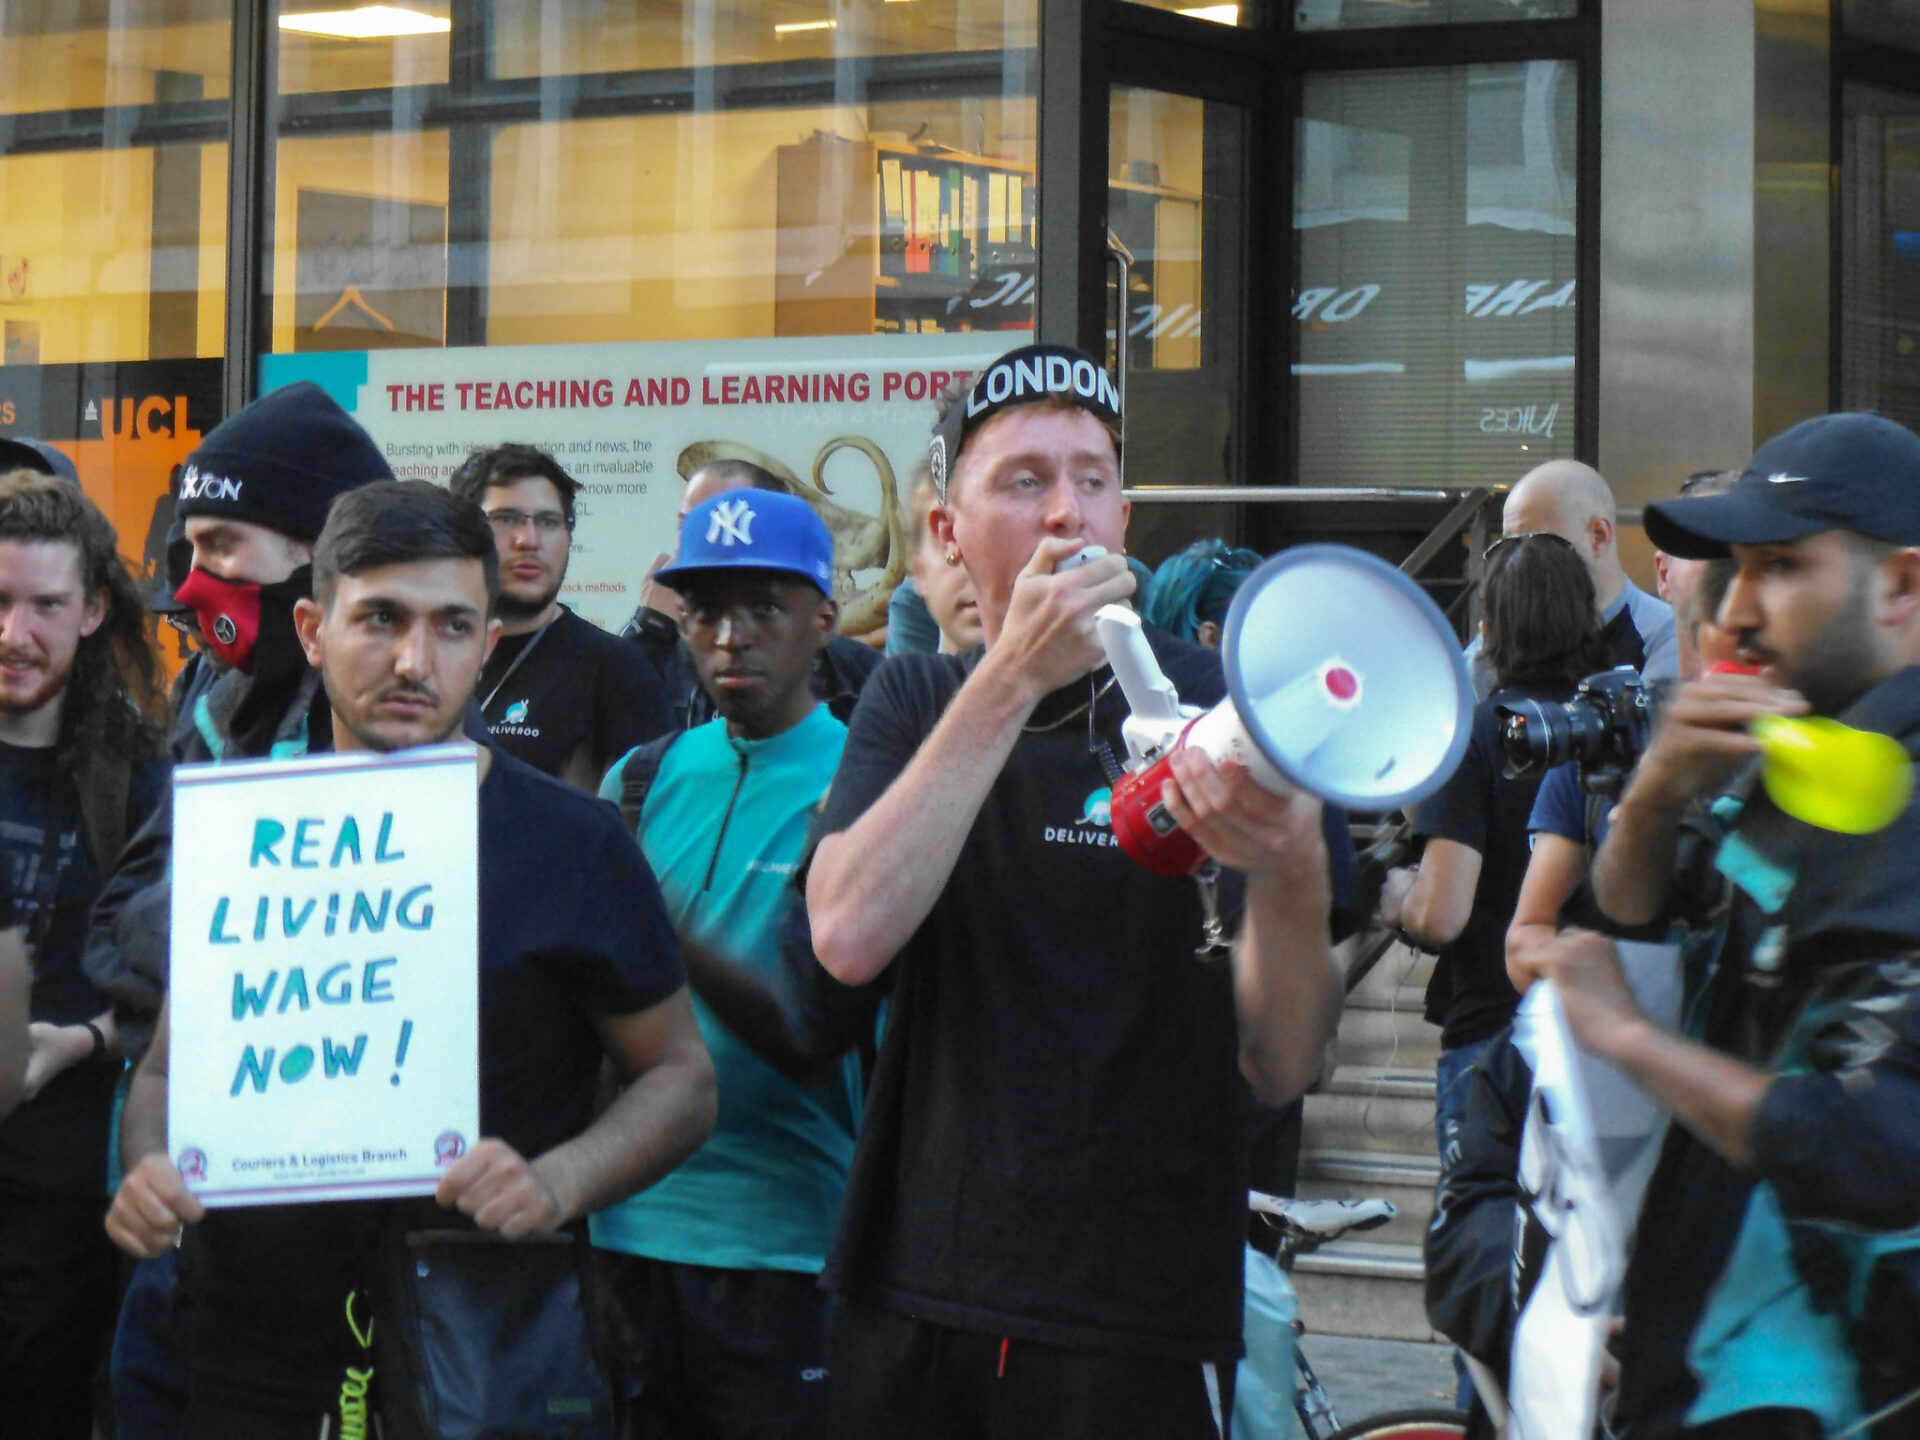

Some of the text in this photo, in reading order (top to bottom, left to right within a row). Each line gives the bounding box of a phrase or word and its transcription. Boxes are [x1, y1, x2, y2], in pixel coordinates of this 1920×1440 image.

[386, 371, 974, 412] THE TEACHING AND LEARNING PORT
[967, 355, 1120, 418] LONDON
[101, 395, 202, 440] UCL
[386, 442, 433, 458] Bursting
[437, 442, 459, 455] with
[568, 440, 592, 453] and
[595, 441, 629, 453] news,
[633, 440, 653, 452] the
[390, 464, 438, 479] eaching
[441, 464, 460, 476] an
[574, 463, 590, 474] an
[593, 460, 655, 474] invaluable
[616, 484, 648, 496] more
[574, 502, 594, 516] CL.
[705, 499, 757, 546] NY
[585, 581, 627, 593] methods
[248, 811, 405, 869] REAL
[1044, 826, 1119, 847] DELIVER
[208, 884, 434, 945] LIVING
[231, 957, 398, 1021] WAGE
[232, 1148, 408, 1172] Couriers & Logistics Branch
